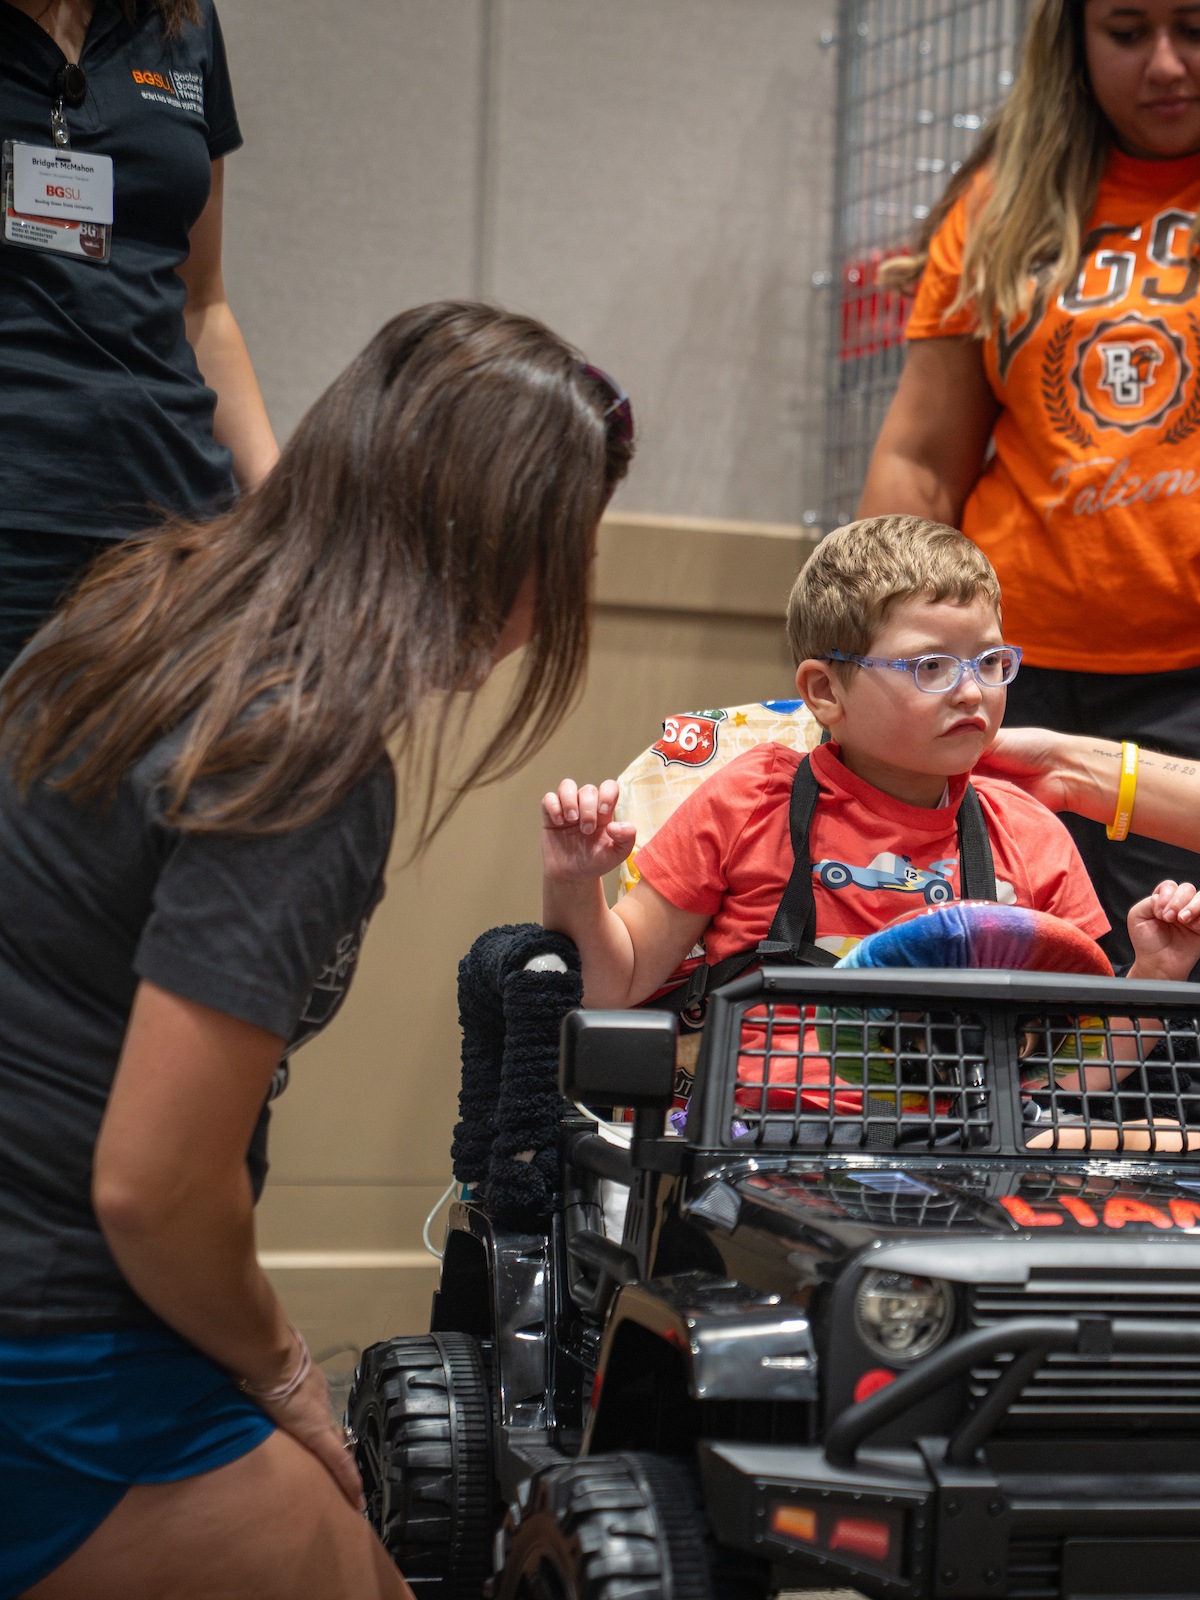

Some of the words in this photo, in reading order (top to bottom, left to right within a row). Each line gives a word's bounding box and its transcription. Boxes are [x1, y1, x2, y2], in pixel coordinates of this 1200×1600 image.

[32, 158, 58, 169] Bridget
[60, 162, 94, 173] McMahon
[46, 184, 81, 200] BGSU
[662, 718, 701, 752] 66
[905, 869, 918, 881] 12
